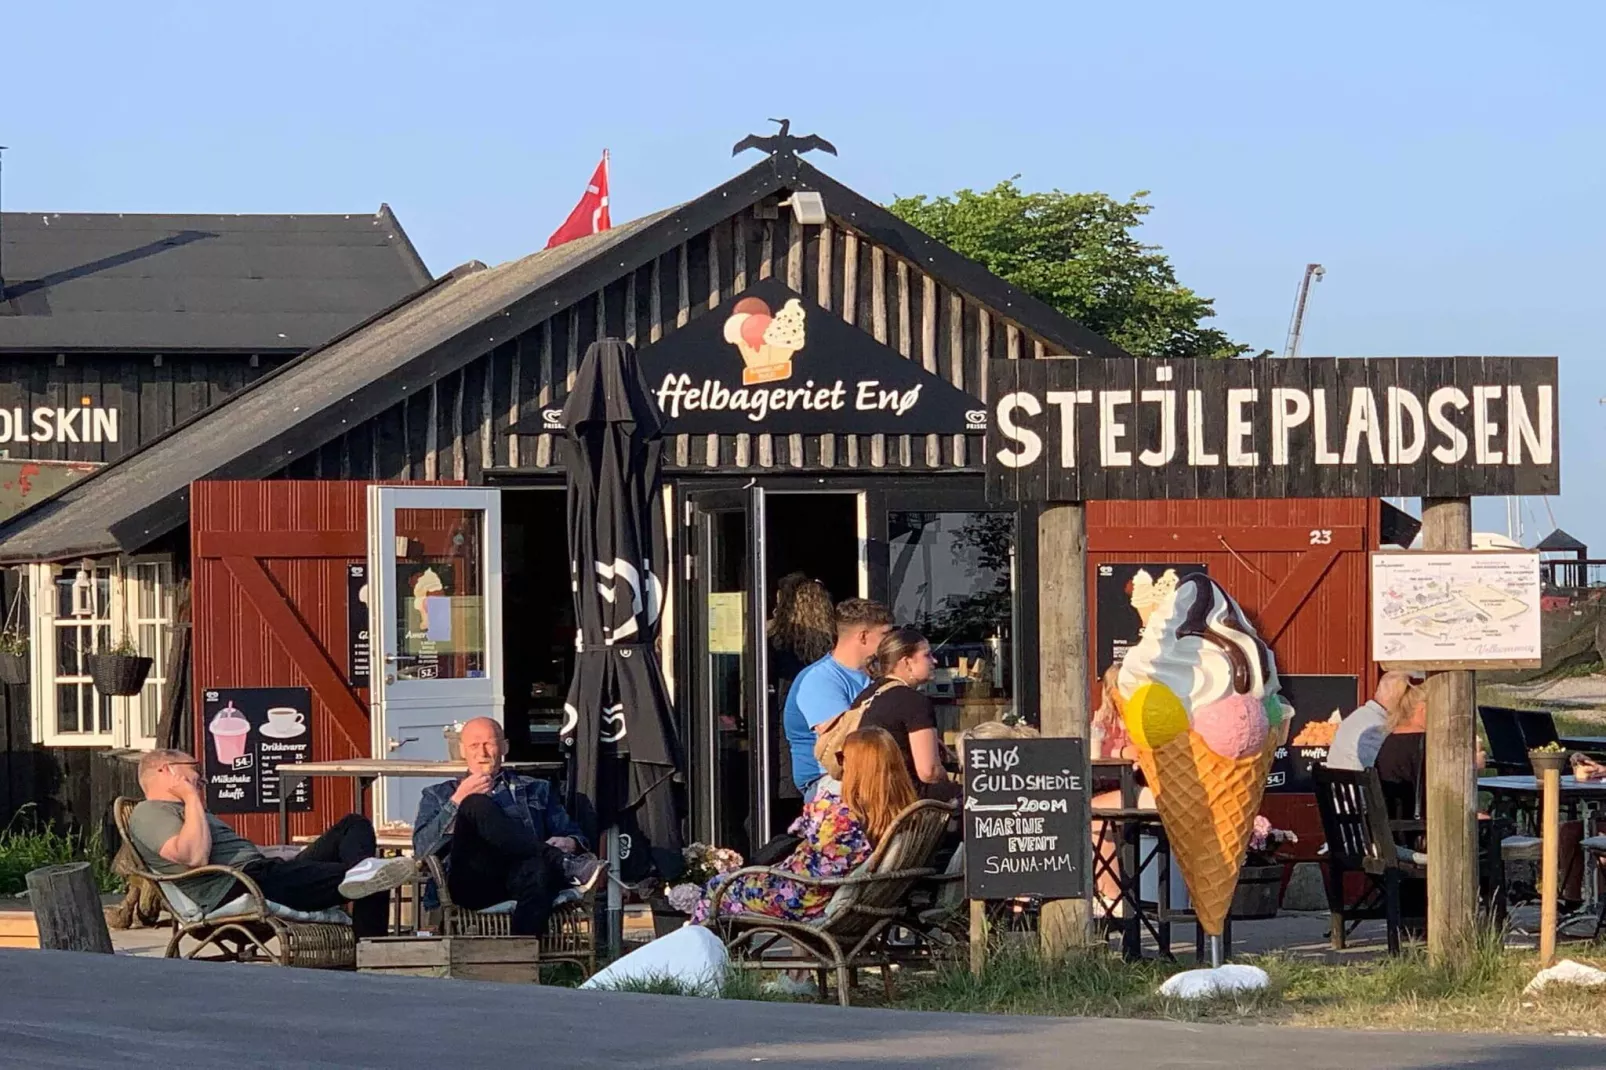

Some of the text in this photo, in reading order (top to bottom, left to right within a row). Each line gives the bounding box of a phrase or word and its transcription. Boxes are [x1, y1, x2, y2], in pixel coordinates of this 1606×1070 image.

[651, 373, 923, 421] ffelbageriet Enø
[996, 366, 1553, 468] STEJLEPLADSEN
[1309, 530, 1333, 545] 23
[970, 745, 1020, 771] ENØ
[211, 774, 251, 784] Milkshake
[218, 788, 245, 800] Iskaffe
[975, 812, 1045, 839] MARINE
[1008, 836, 1058, 852] EVENT
